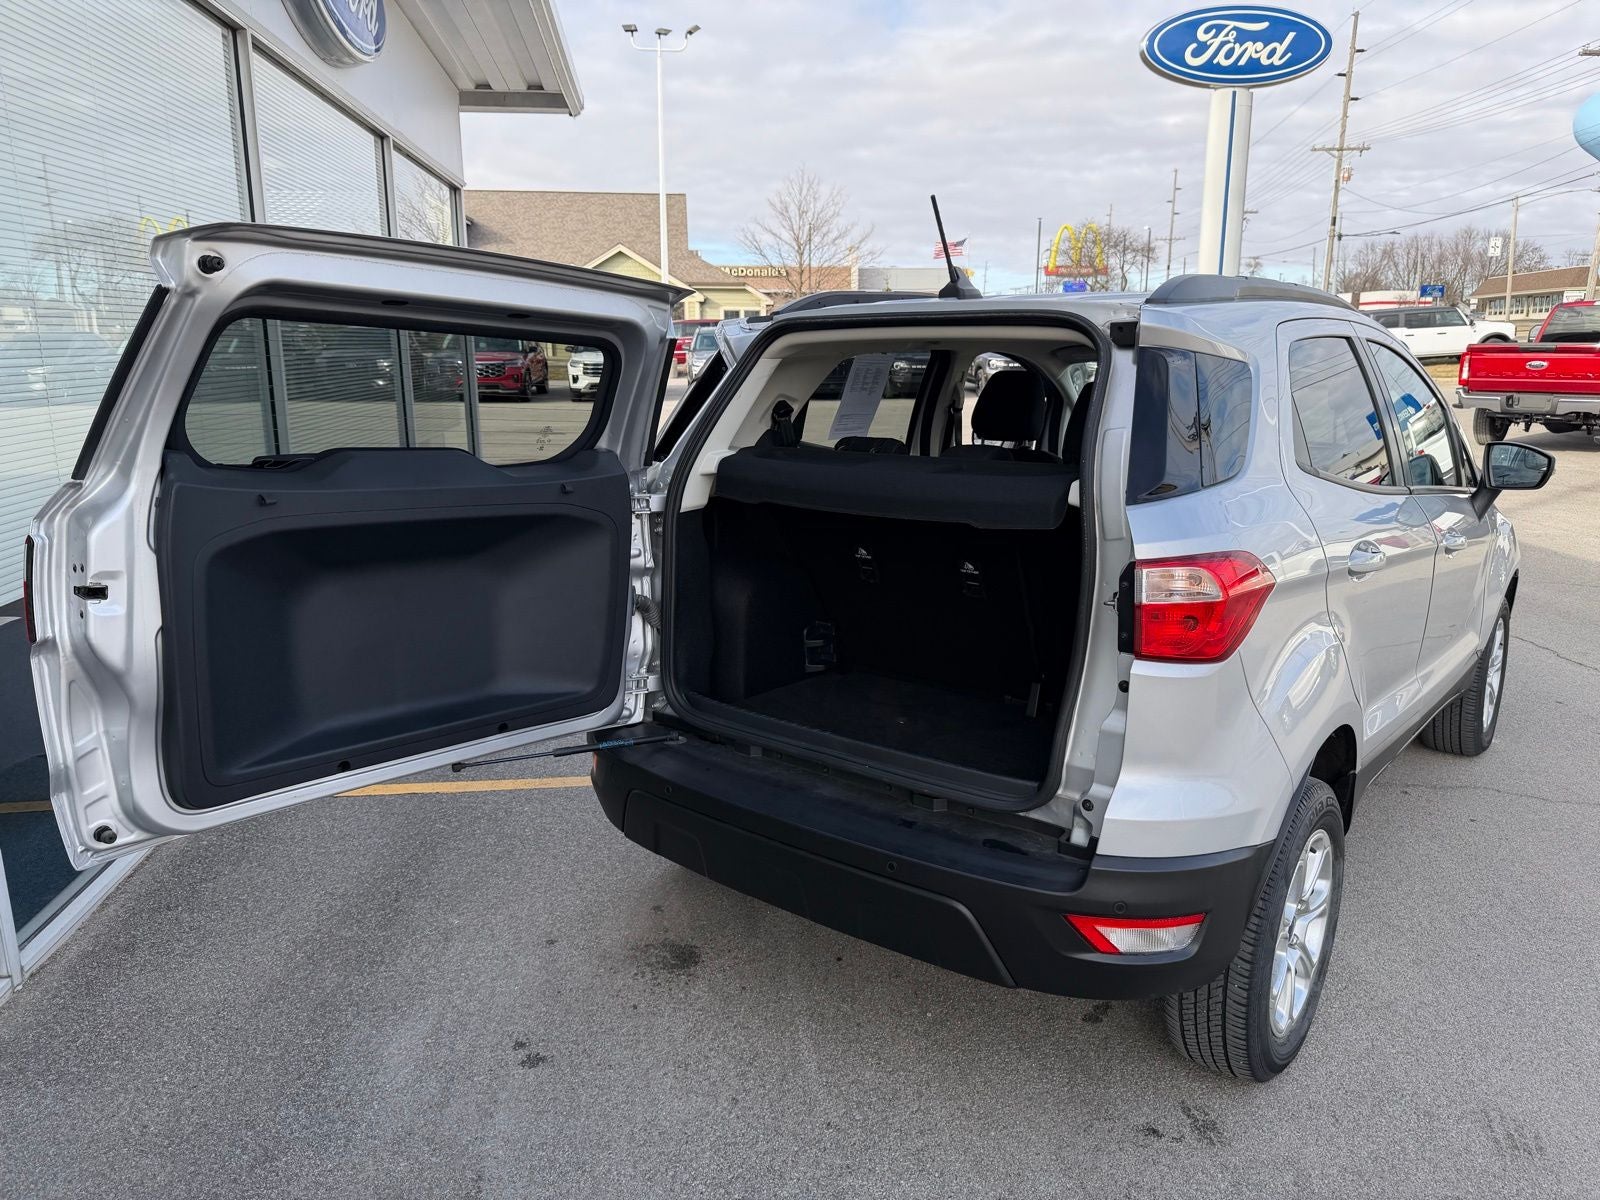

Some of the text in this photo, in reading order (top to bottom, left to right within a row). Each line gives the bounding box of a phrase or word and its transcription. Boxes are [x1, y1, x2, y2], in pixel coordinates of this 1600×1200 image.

[345, 0, 379, 37] rd
[1184, 19, 1297, 67] Ford
[720, 266, 787, 277] McDonald's
